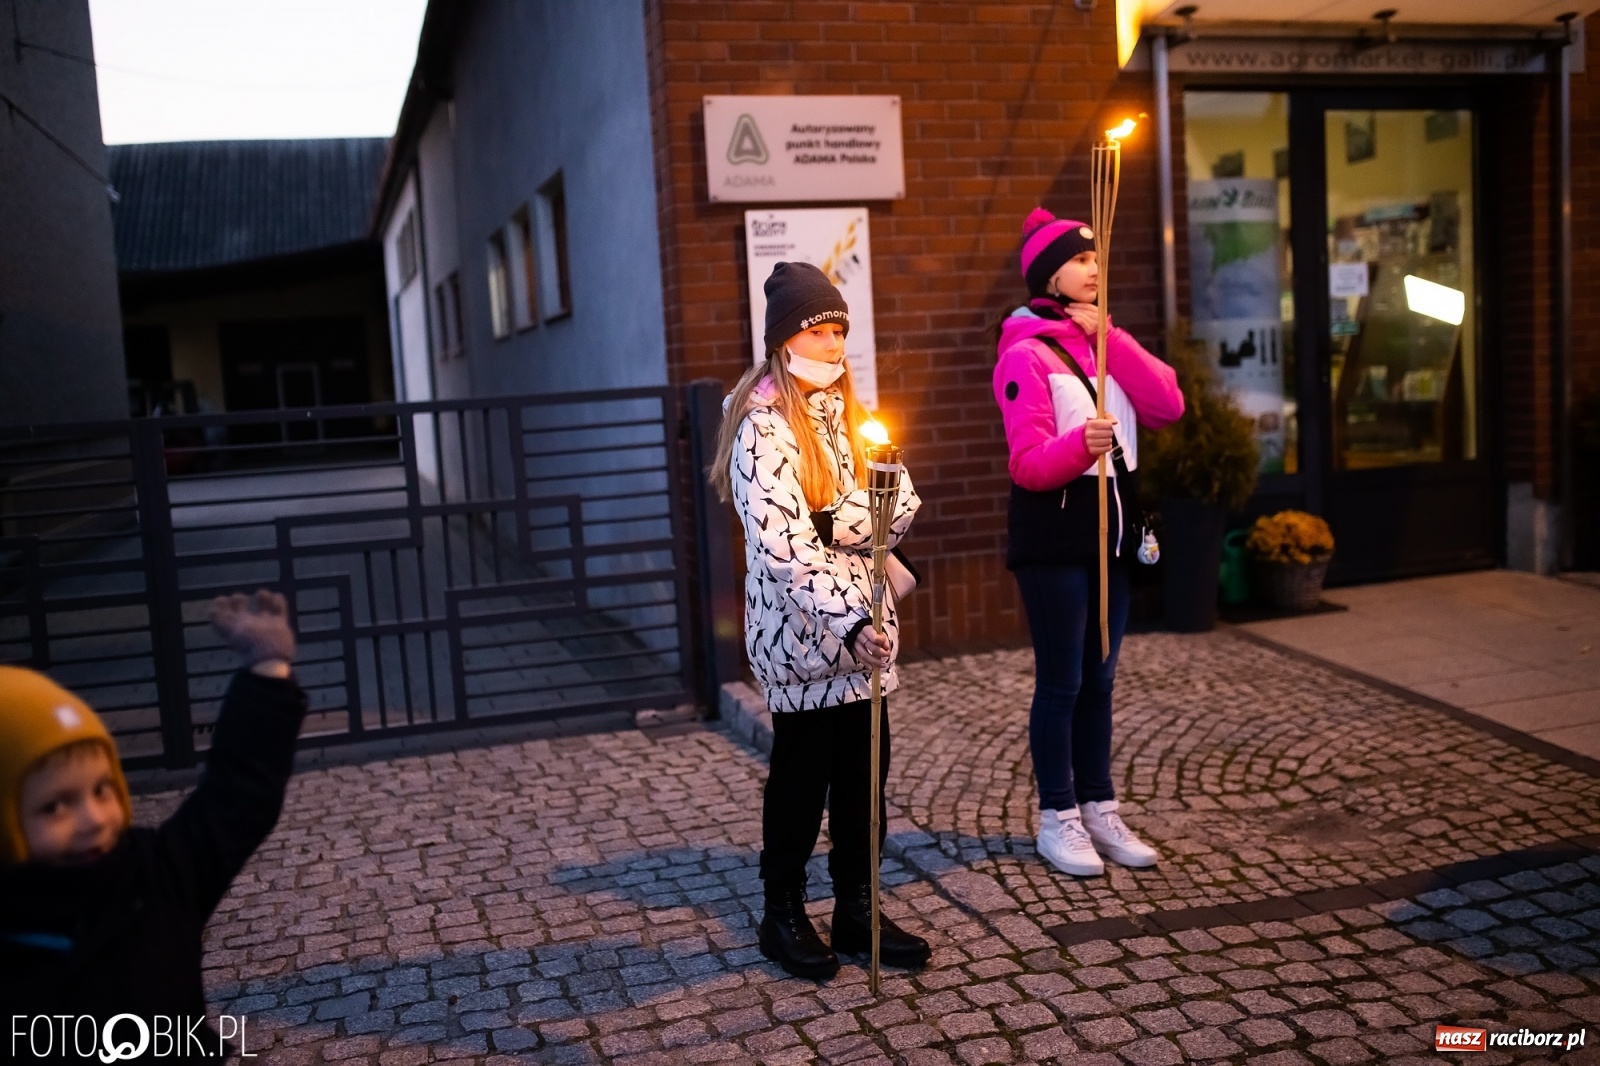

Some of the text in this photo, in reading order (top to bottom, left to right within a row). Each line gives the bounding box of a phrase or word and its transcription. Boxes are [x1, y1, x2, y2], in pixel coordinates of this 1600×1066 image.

[791, 123, 876, 136] Autoryzowany
[785, 138, 881, 152] punkt handlowy
[793, 153, 877, 164] ADAMA Polska
[723, 174, 776, 187] ADAMA
